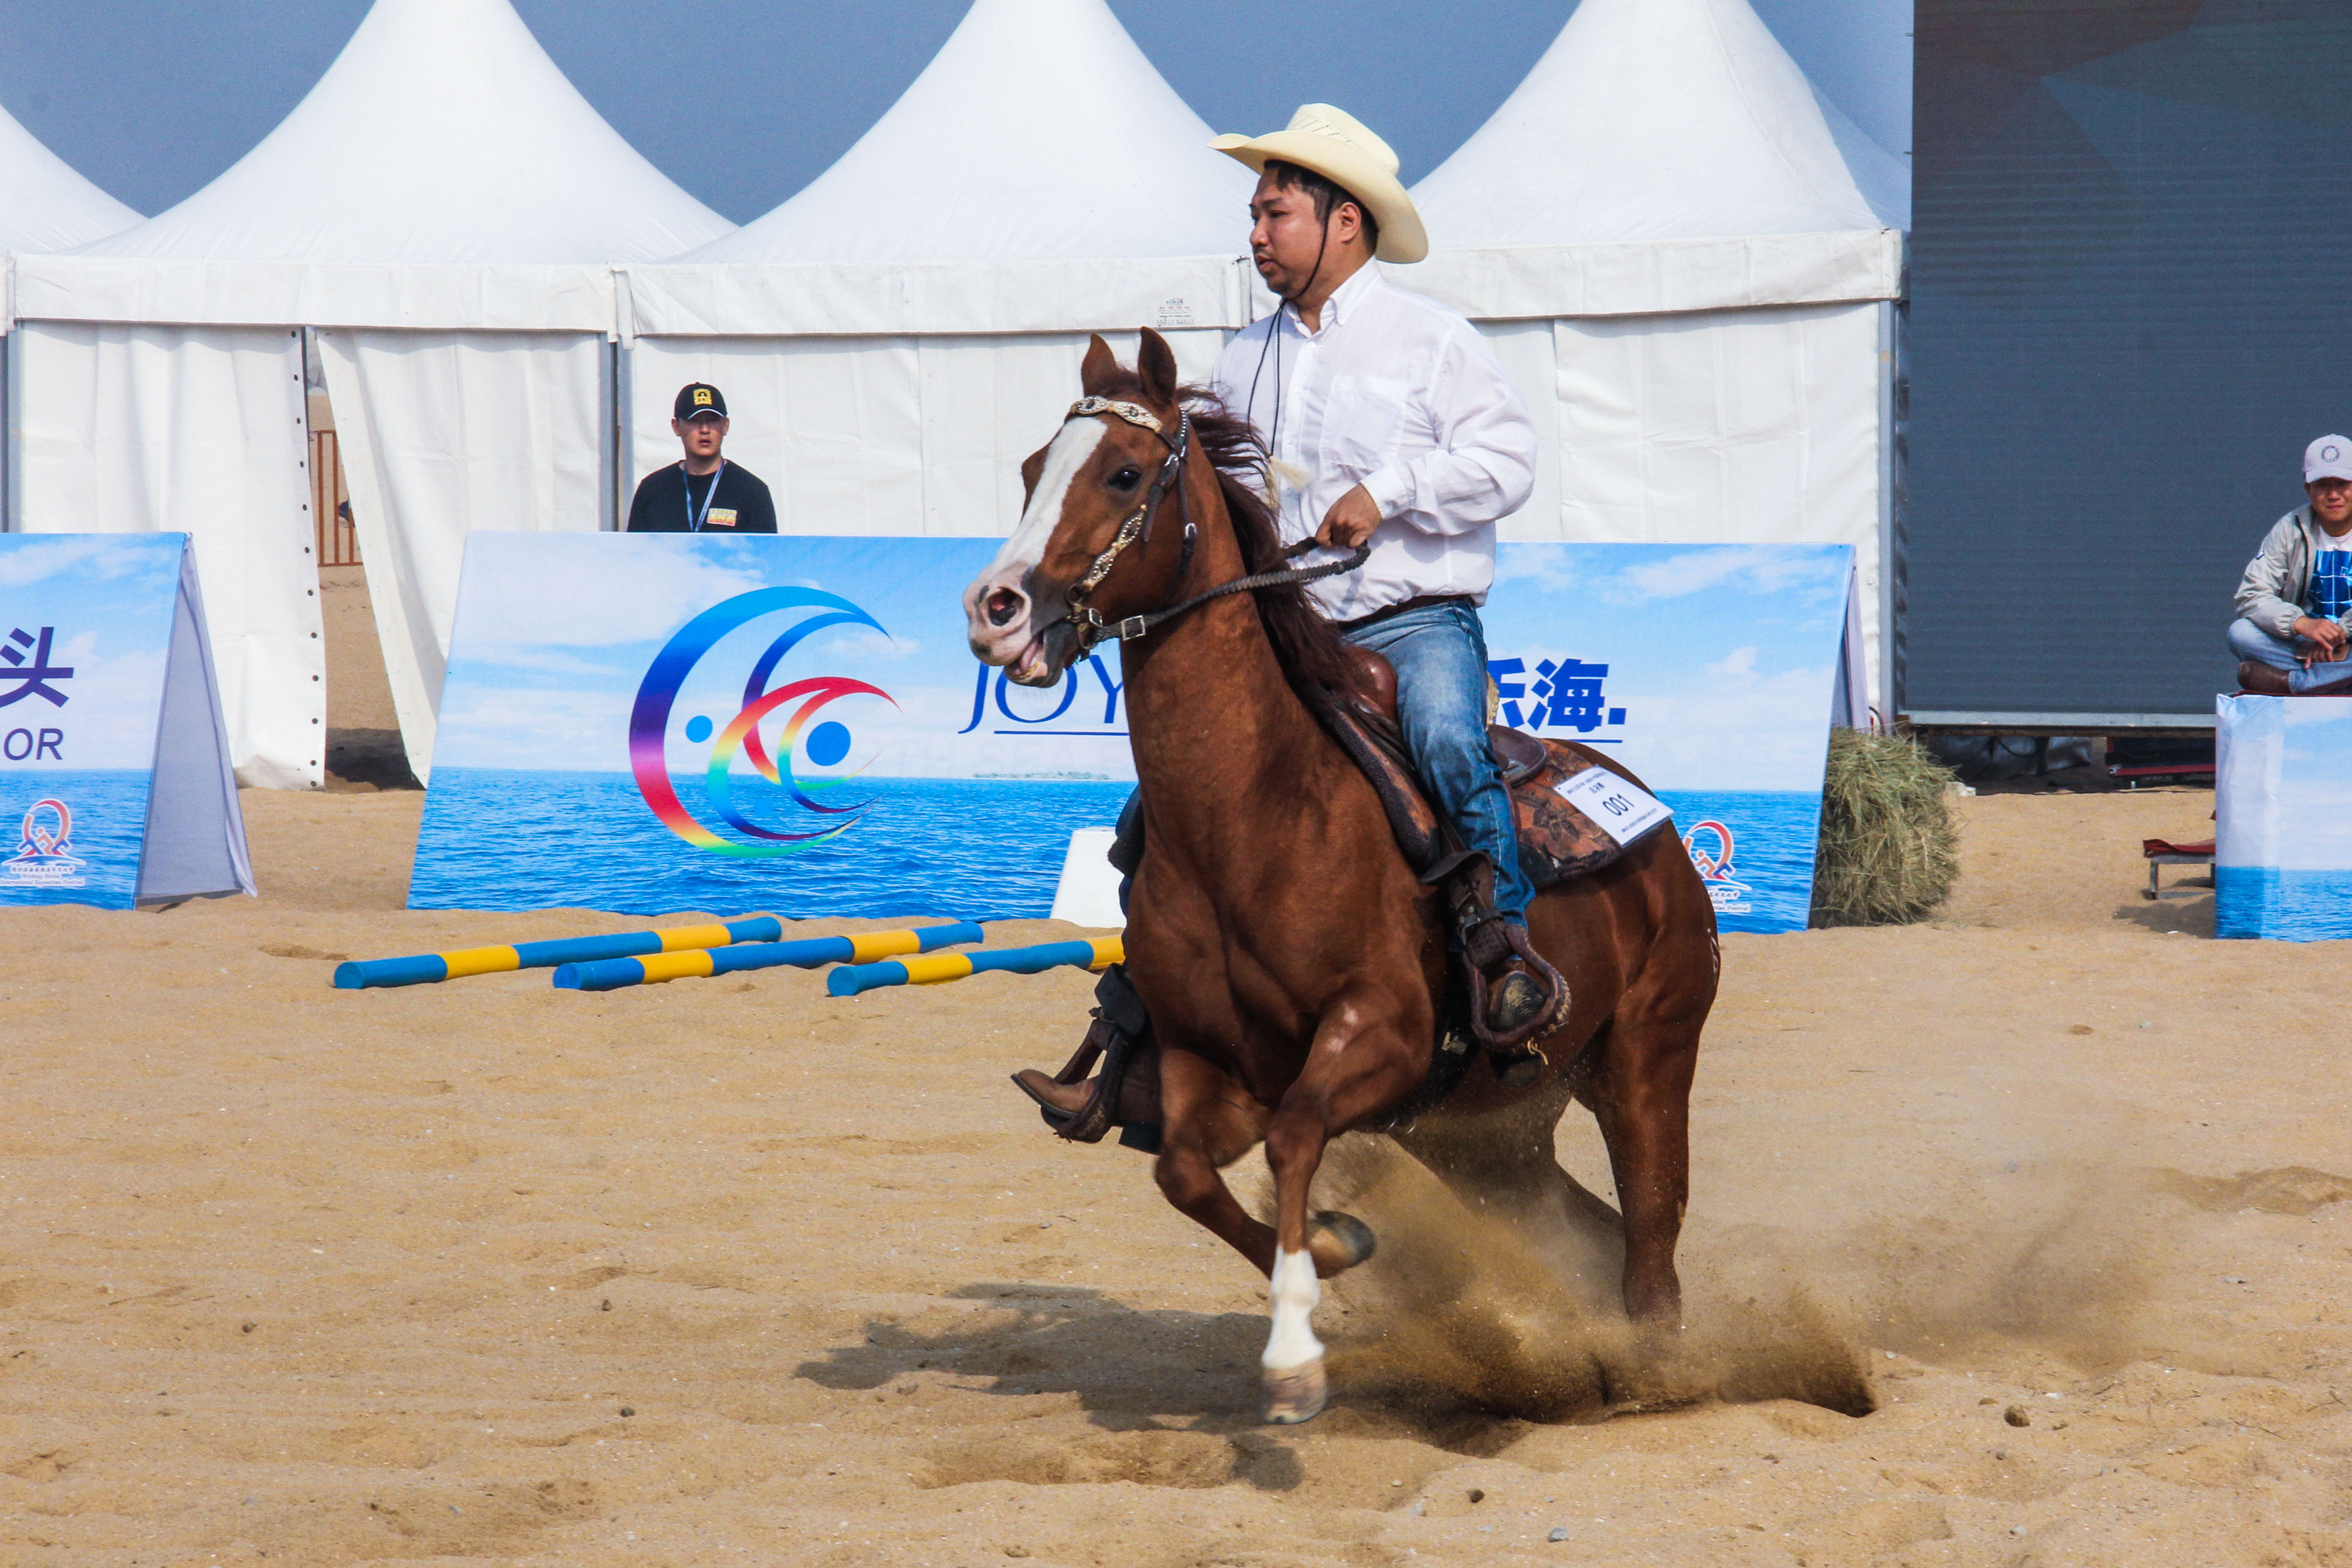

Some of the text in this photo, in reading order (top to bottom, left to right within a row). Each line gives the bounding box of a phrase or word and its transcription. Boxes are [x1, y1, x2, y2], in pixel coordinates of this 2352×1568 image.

[0, 627, 74, 707] 头
[3, 727, 64, 761] OR
[1602, 792, 1635, 816] 001
